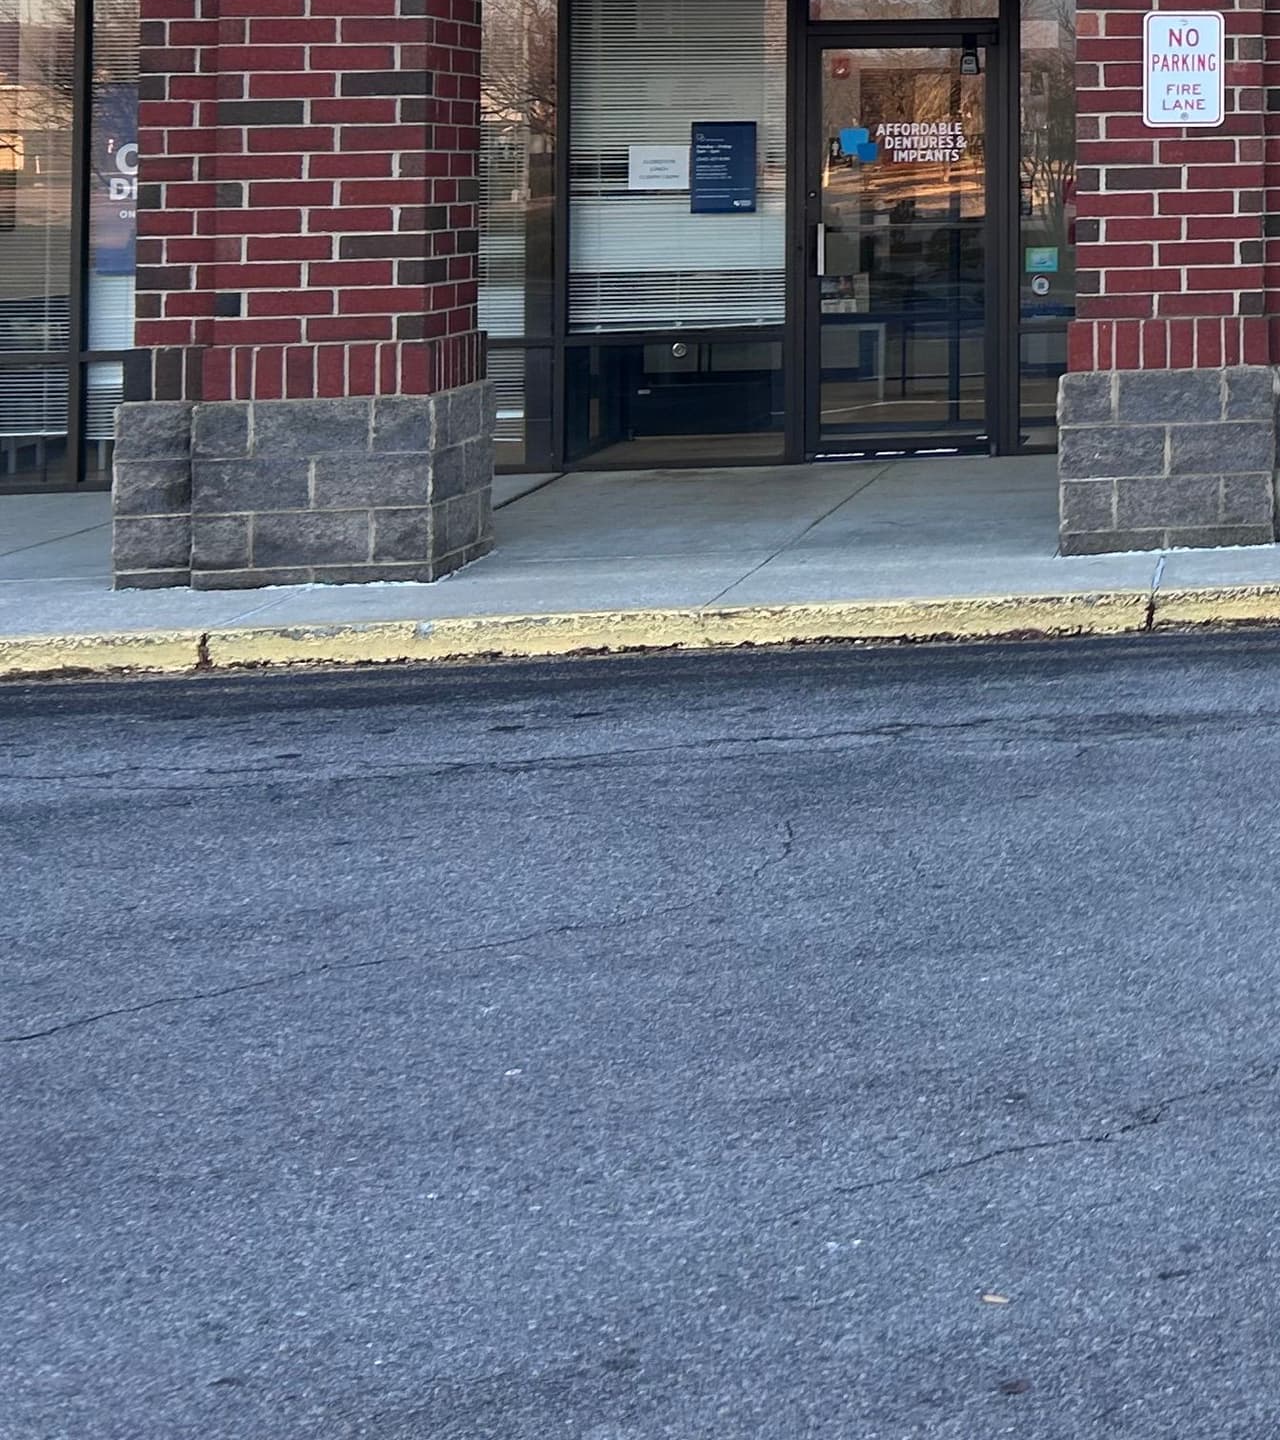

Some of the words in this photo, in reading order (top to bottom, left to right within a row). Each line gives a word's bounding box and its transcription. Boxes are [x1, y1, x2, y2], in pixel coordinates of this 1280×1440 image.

[1168, 28, 1200, 47] NO
[1151, 53, 1216, 72] PARKING
[1166, 83, 1202, 95] FIRE
[1162, 99, 1206, 110] LANE
[876, 122, 963, 136] AFFORDABLE
[884, 136, 956, 149] DENTURES
[956, 136, 967, 148] &
[893, 149, 960, 162] IMPLANTS
